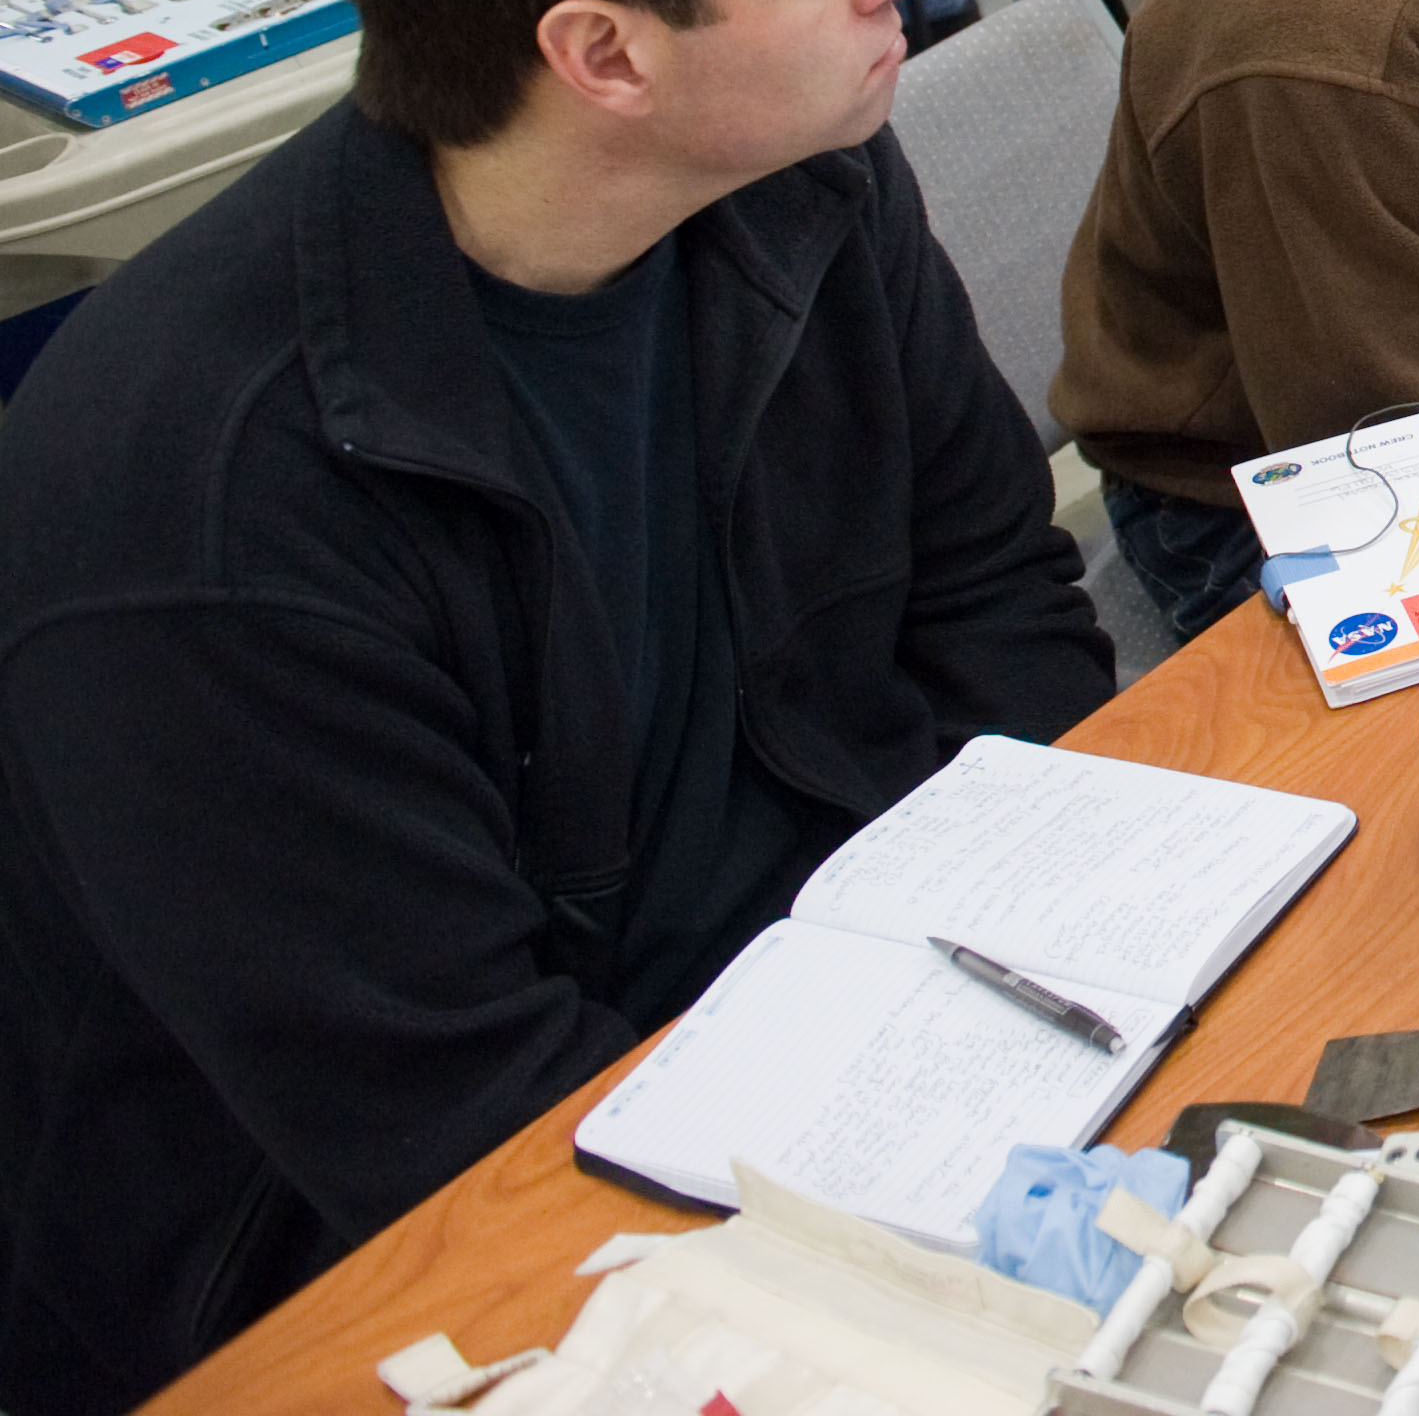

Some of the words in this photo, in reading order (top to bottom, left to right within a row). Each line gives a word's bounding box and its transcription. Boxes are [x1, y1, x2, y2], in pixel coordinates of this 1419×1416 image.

[1380, 433, 1414, 447] CREW
[1310, 443, 1376, 466] NOTBOOK
[1332, 620, 1394, 647] NASA
